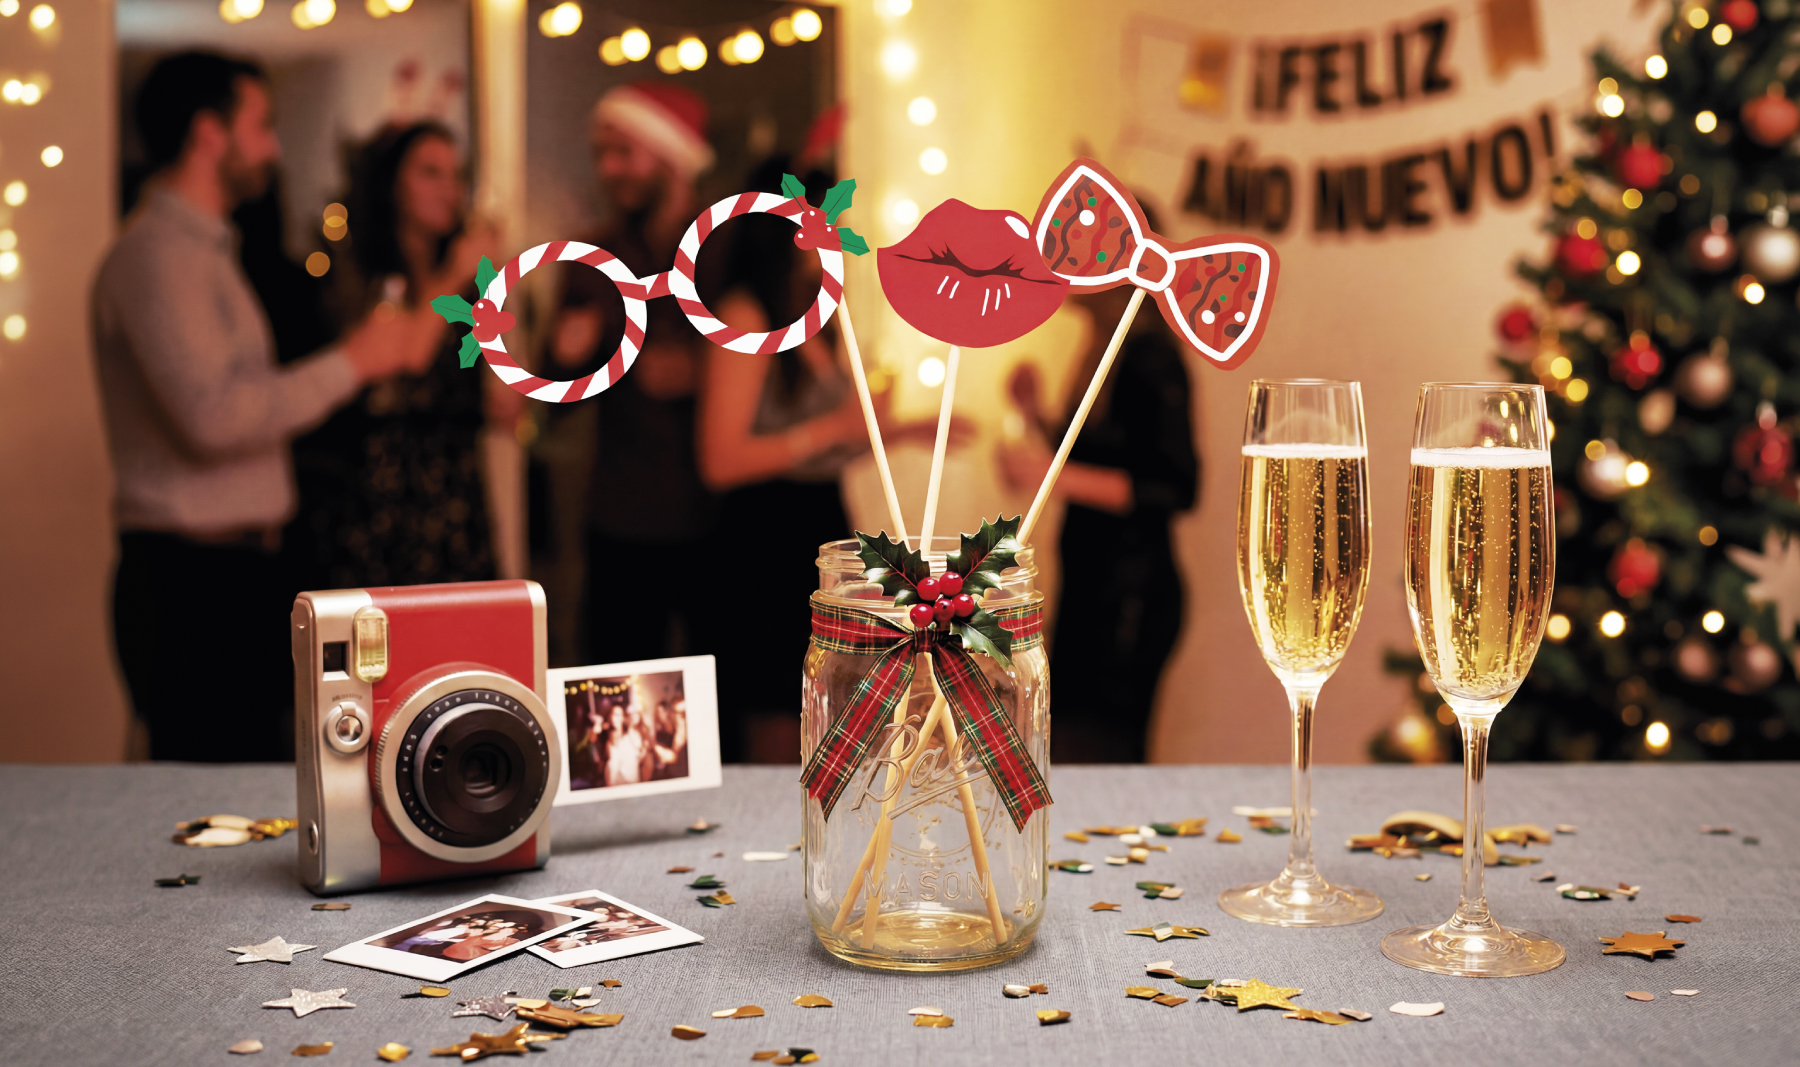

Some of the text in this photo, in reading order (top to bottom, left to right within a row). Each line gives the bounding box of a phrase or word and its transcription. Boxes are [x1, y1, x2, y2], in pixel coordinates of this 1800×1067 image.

[1182, 107, 1556, 235] AÑO NUEVO!
[863, 870, 991, 902] MASON
